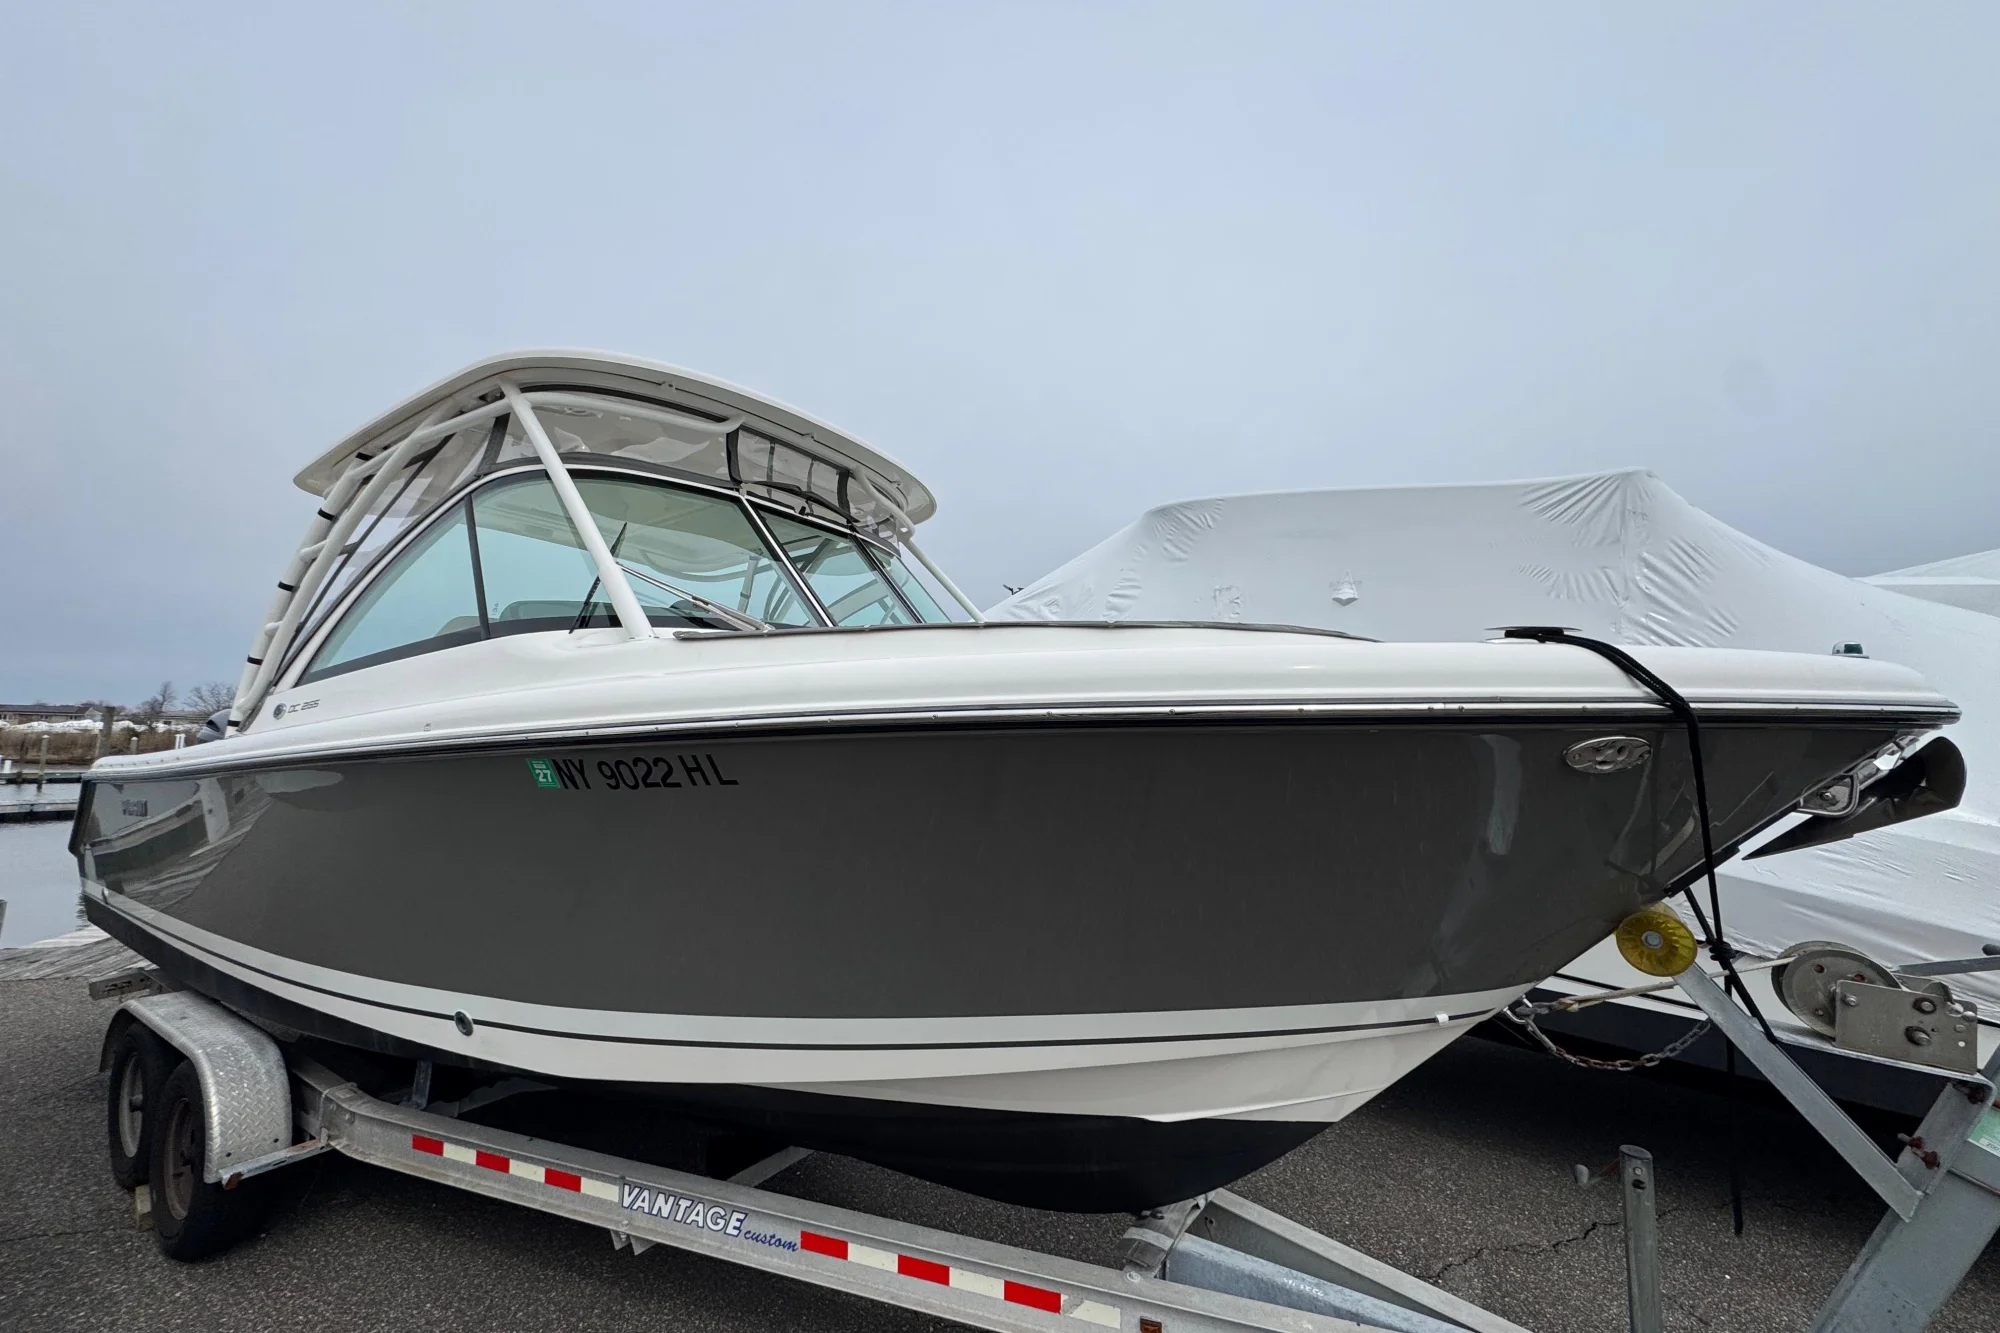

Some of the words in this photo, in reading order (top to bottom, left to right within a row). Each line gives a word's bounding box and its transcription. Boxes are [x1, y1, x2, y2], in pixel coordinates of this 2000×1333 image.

[535, 769, 552, 783] 27
[551, 758, 592, 790] NY
[597, 757, 682, 790] 9022
[677, 754, 740, 786] HL
[621, 1183, 748, 1238] VANTAGE
[743, 1229, 799, 1252] custom
